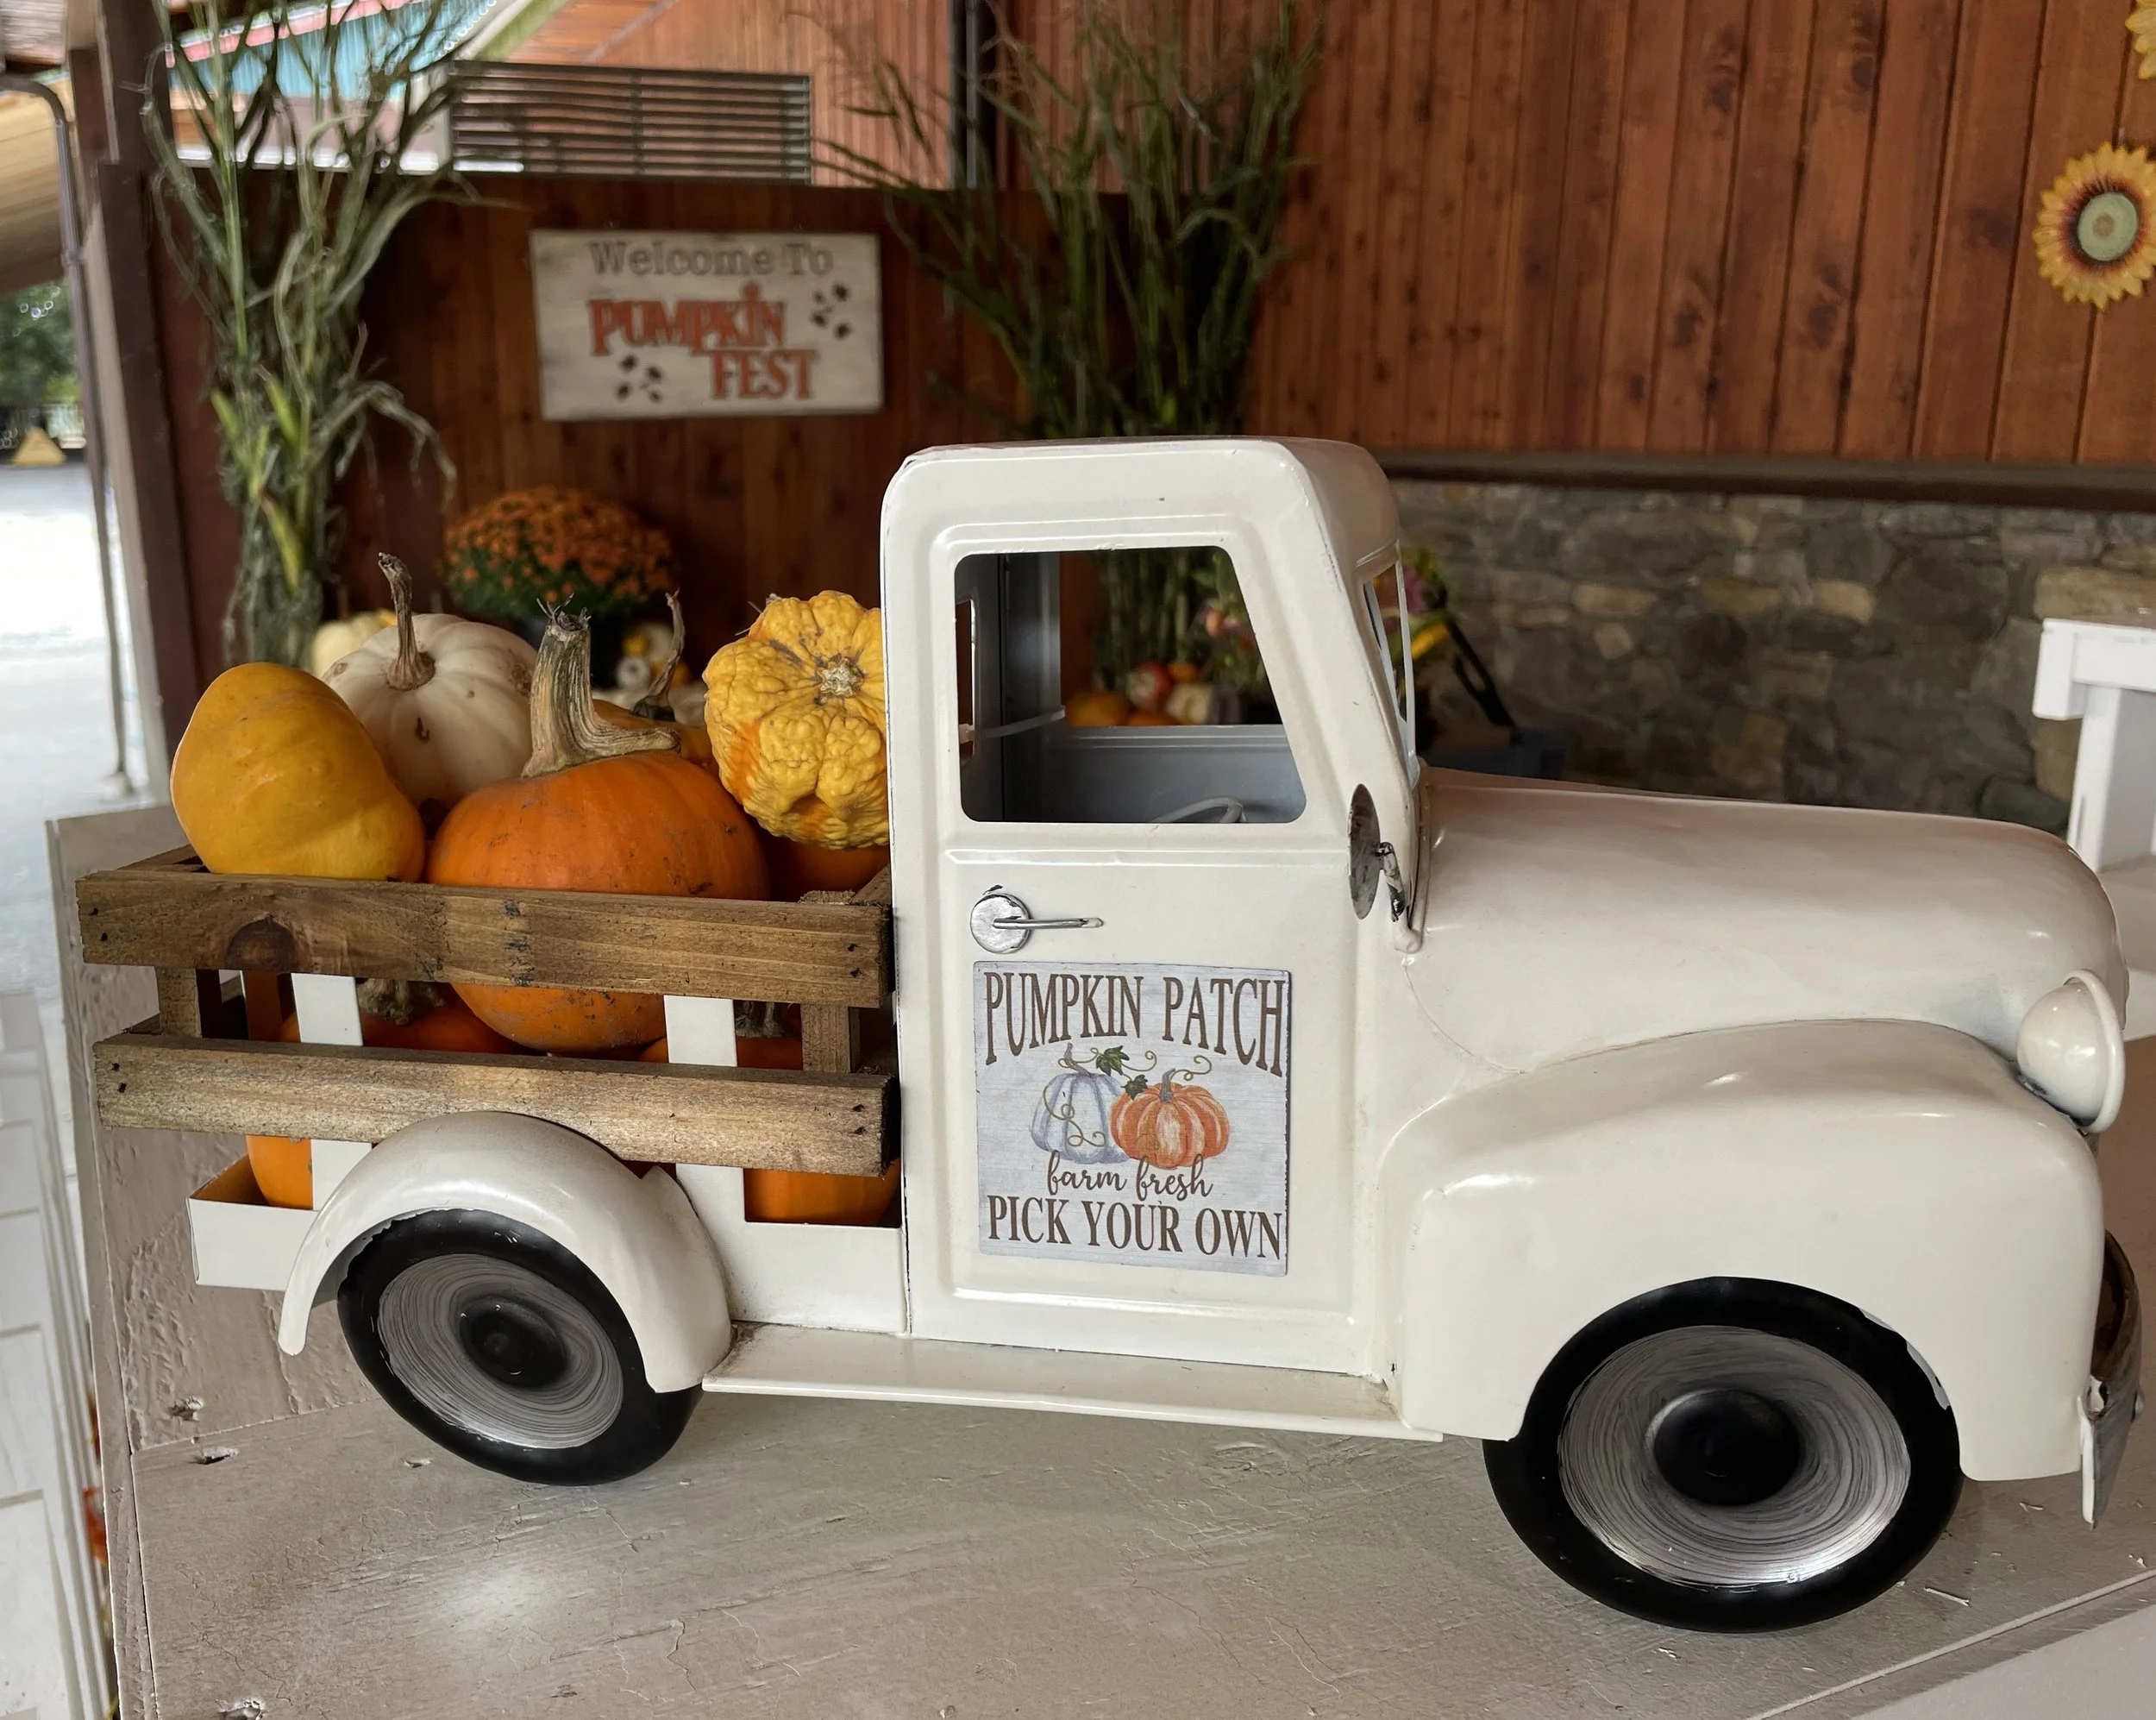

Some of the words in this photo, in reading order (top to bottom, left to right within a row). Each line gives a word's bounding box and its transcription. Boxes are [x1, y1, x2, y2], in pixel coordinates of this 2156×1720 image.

[588, 241, 774, 276] Welcome
[783, 242, 835, 276] To
[711, 348, 818, 399] FEST
[984, 971, 1144, 1065] PUMPKIN
[1162, 976, 1286, 1077] PATCH
[1046, 1150, 1126, 1196] farm
[1135, 1153, 1213, 1202] fresh
[987, 1195, 1071, 1245] PICK
[1081, 1200, 1183, 1252] YOUR
[1195, 1208, 1282, 1259] OWN
